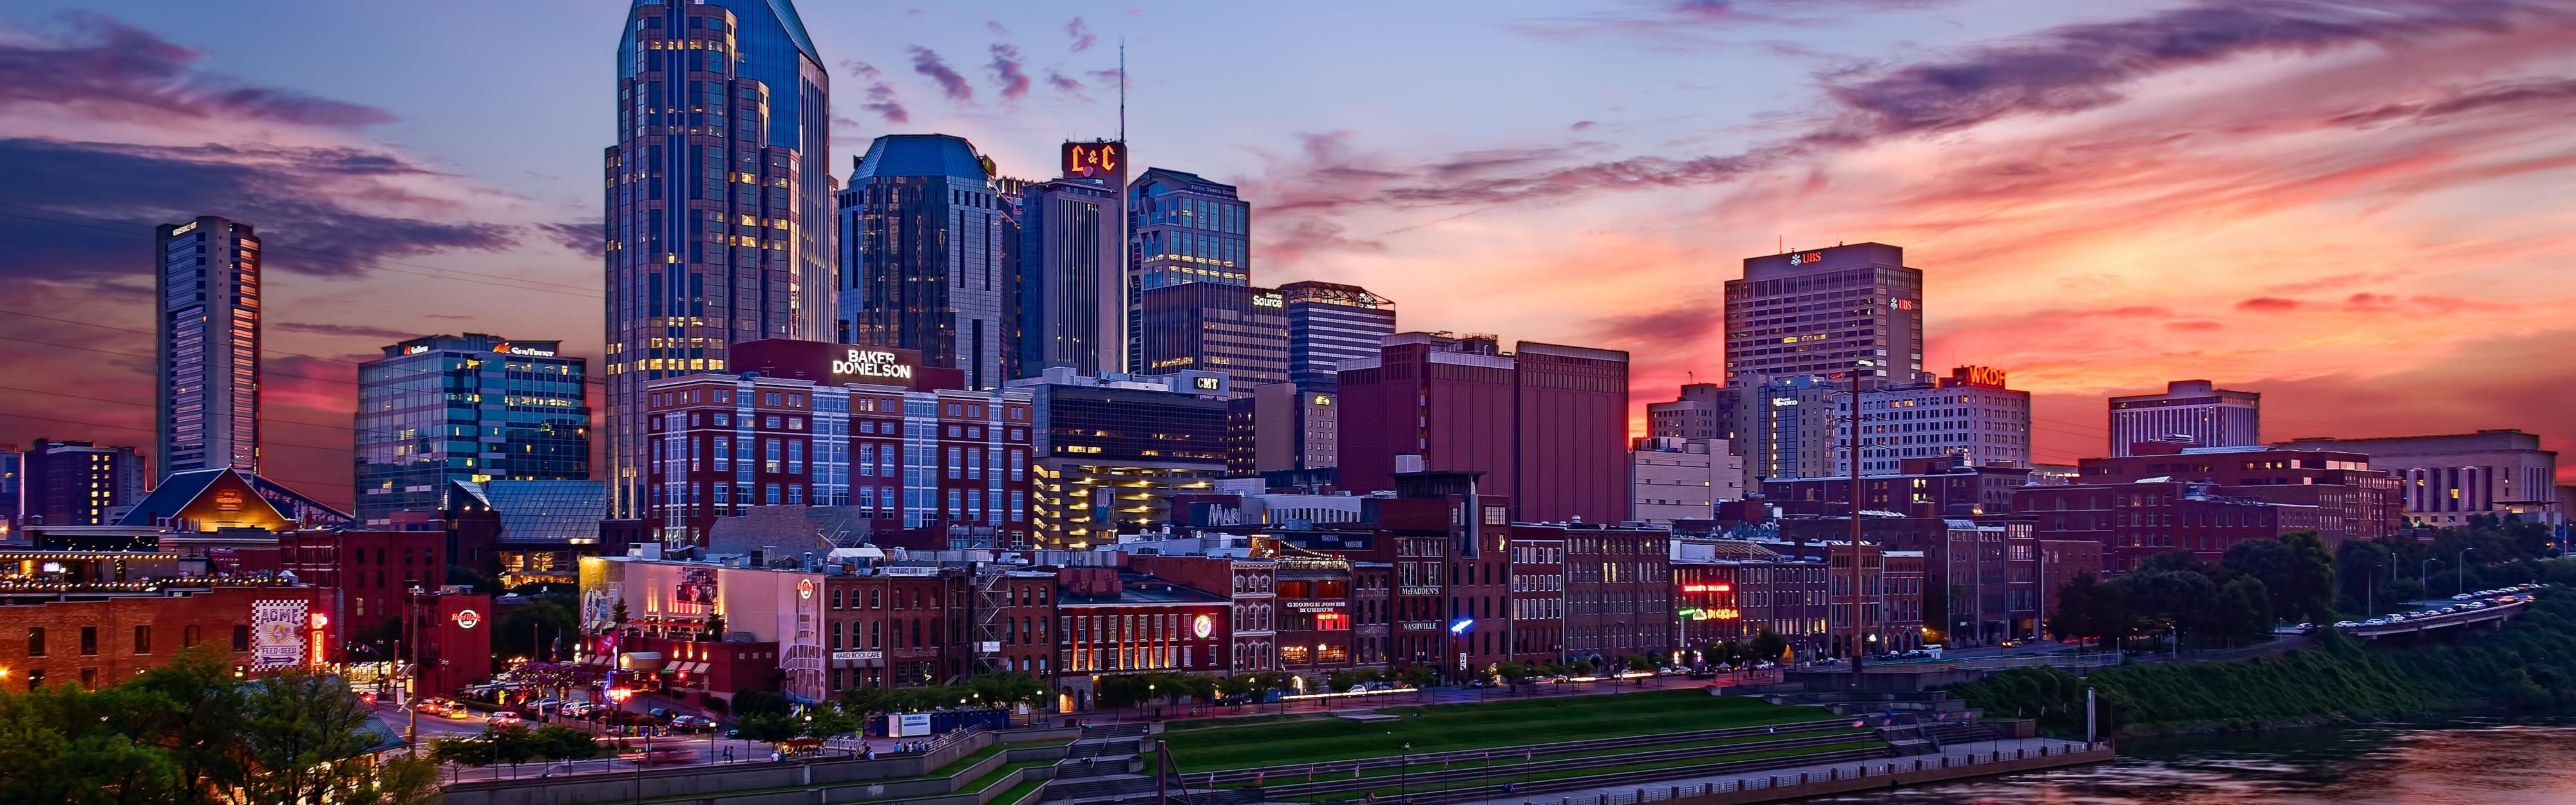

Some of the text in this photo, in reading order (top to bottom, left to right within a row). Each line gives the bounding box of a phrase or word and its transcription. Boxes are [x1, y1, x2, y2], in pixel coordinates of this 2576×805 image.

[1803, 252, 1821, 263] UBS
[1253, 295, 1282, 308] Source
[1899, 299, 1912, 310] UBS
[848, 349, 896, 365] BAKER
[833, 360, 911, 379] DONELSON
[1969, 366, 2006, 386] WKDF
[1198, 377, 1218, 390] CMT
[260, 608, 299, 625] ACME
[1403, 622, 1437, 630] NASHVILLE
